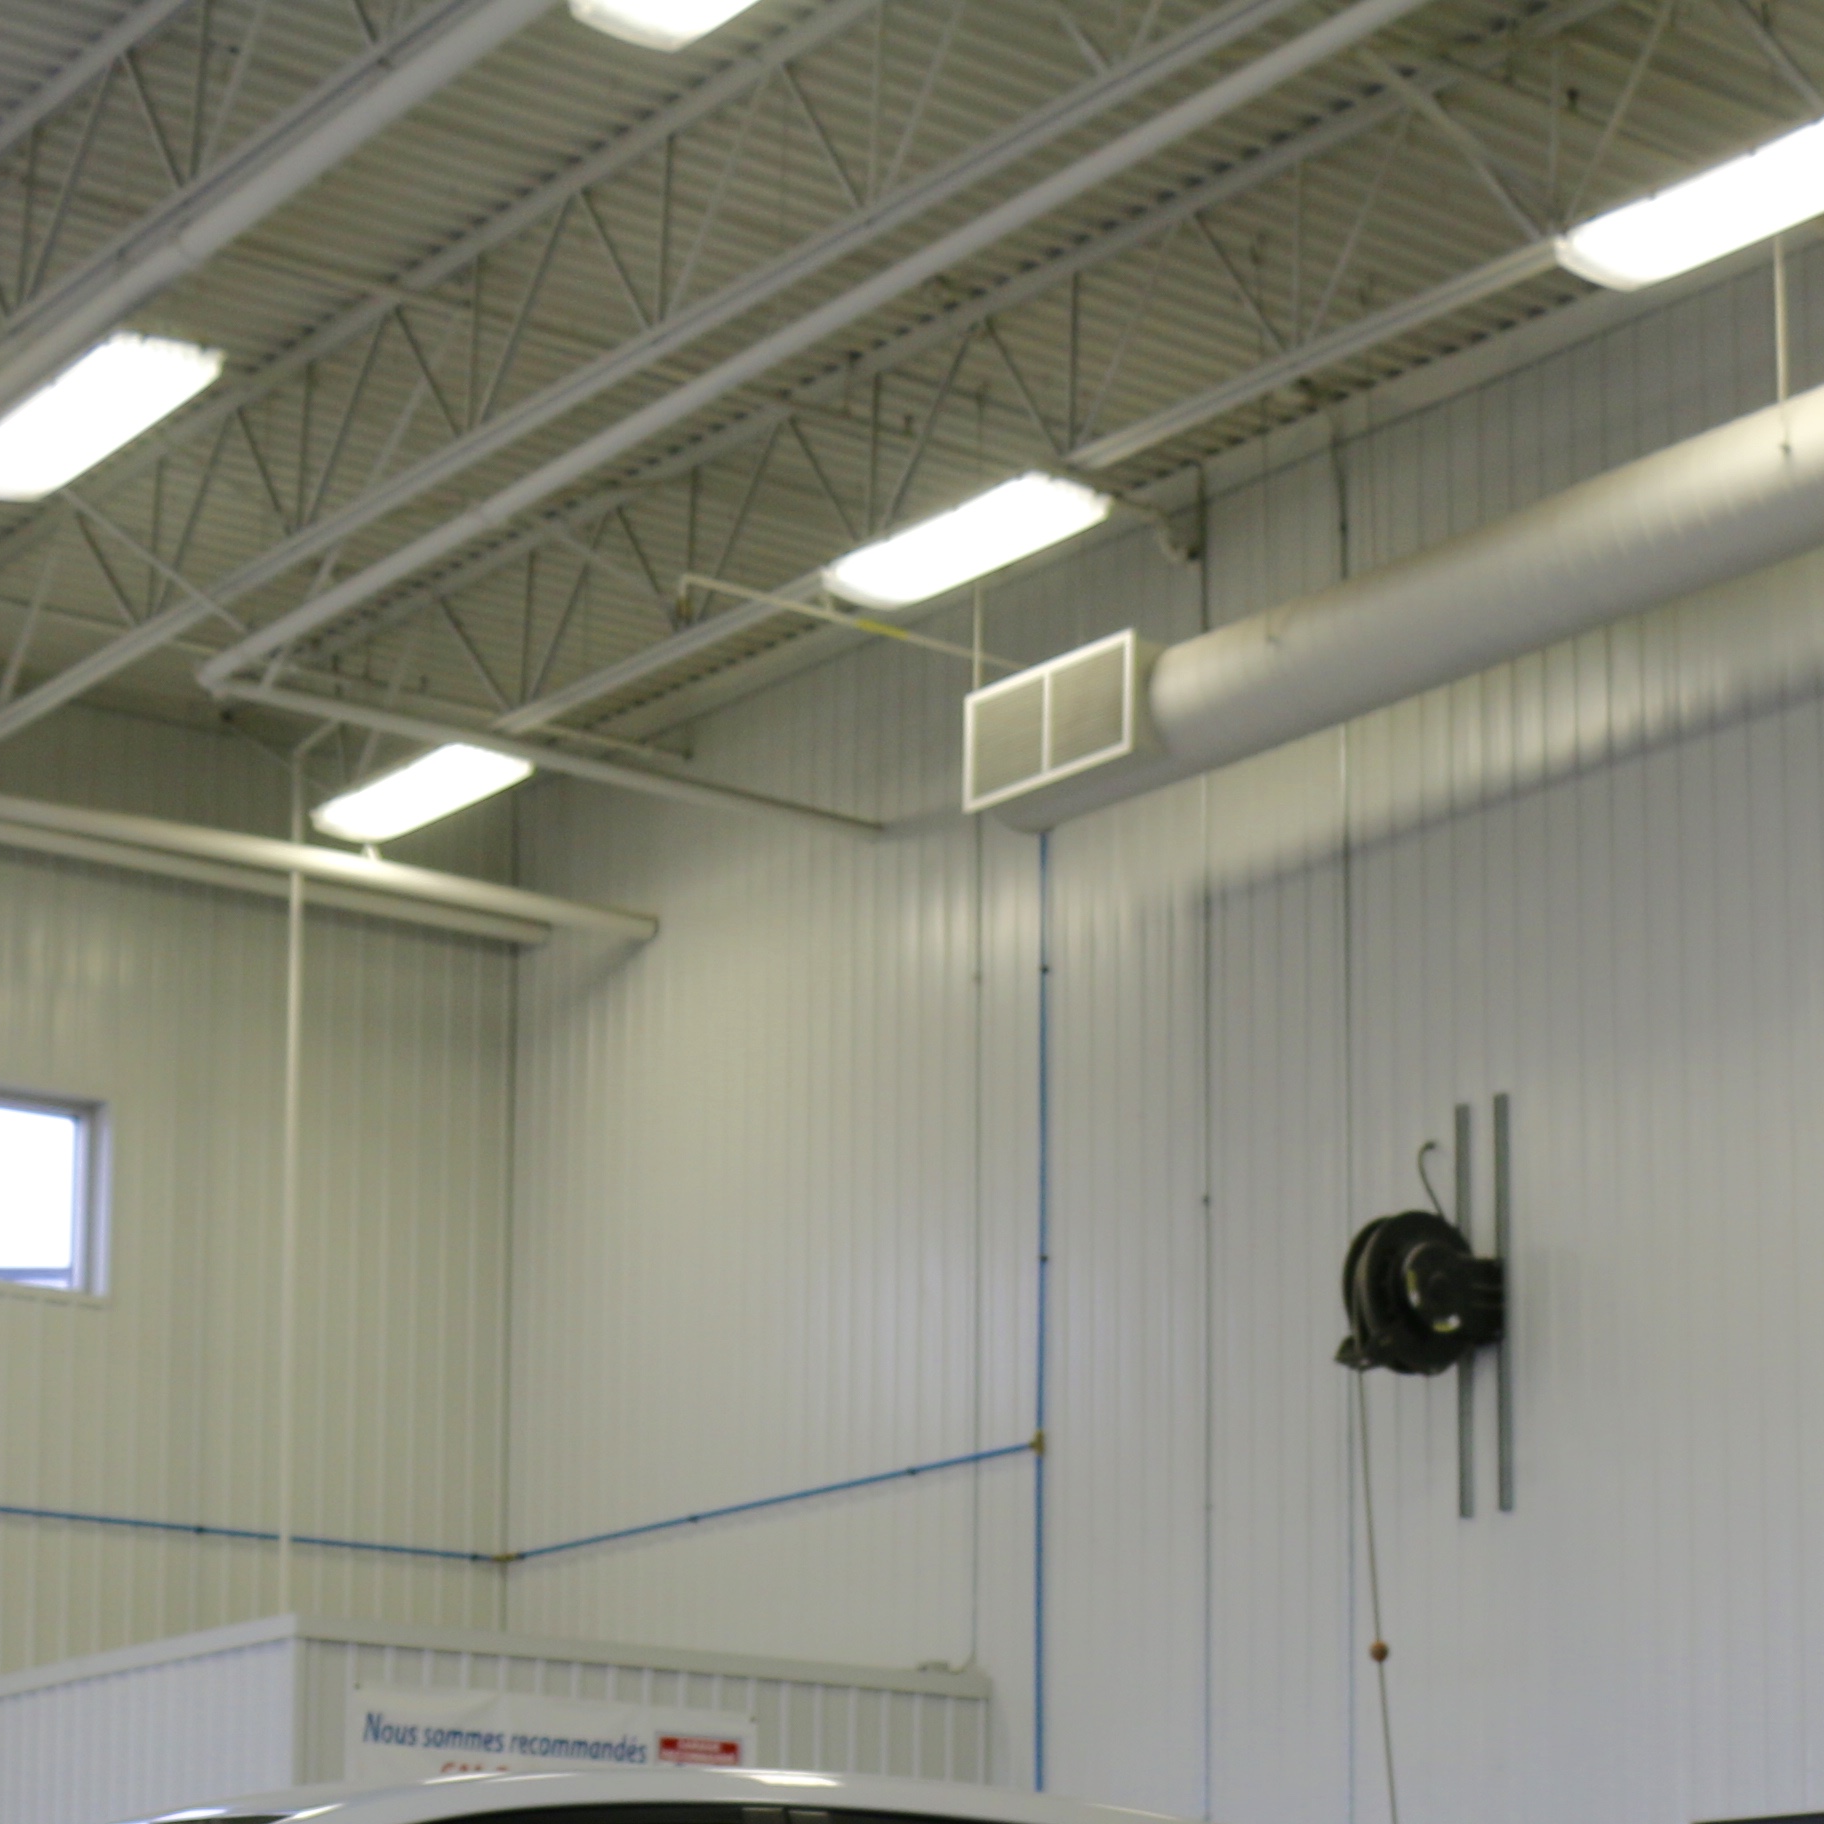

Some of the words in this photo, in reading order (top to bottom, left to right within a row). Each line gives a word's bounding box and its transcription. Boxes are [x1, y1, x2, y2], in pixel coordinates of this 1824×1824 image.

[363, 1711, 417, 1746] Nous
[422, 1726, 505, 1754] sommes
[510, 1733, 648, 1764] recommandés
